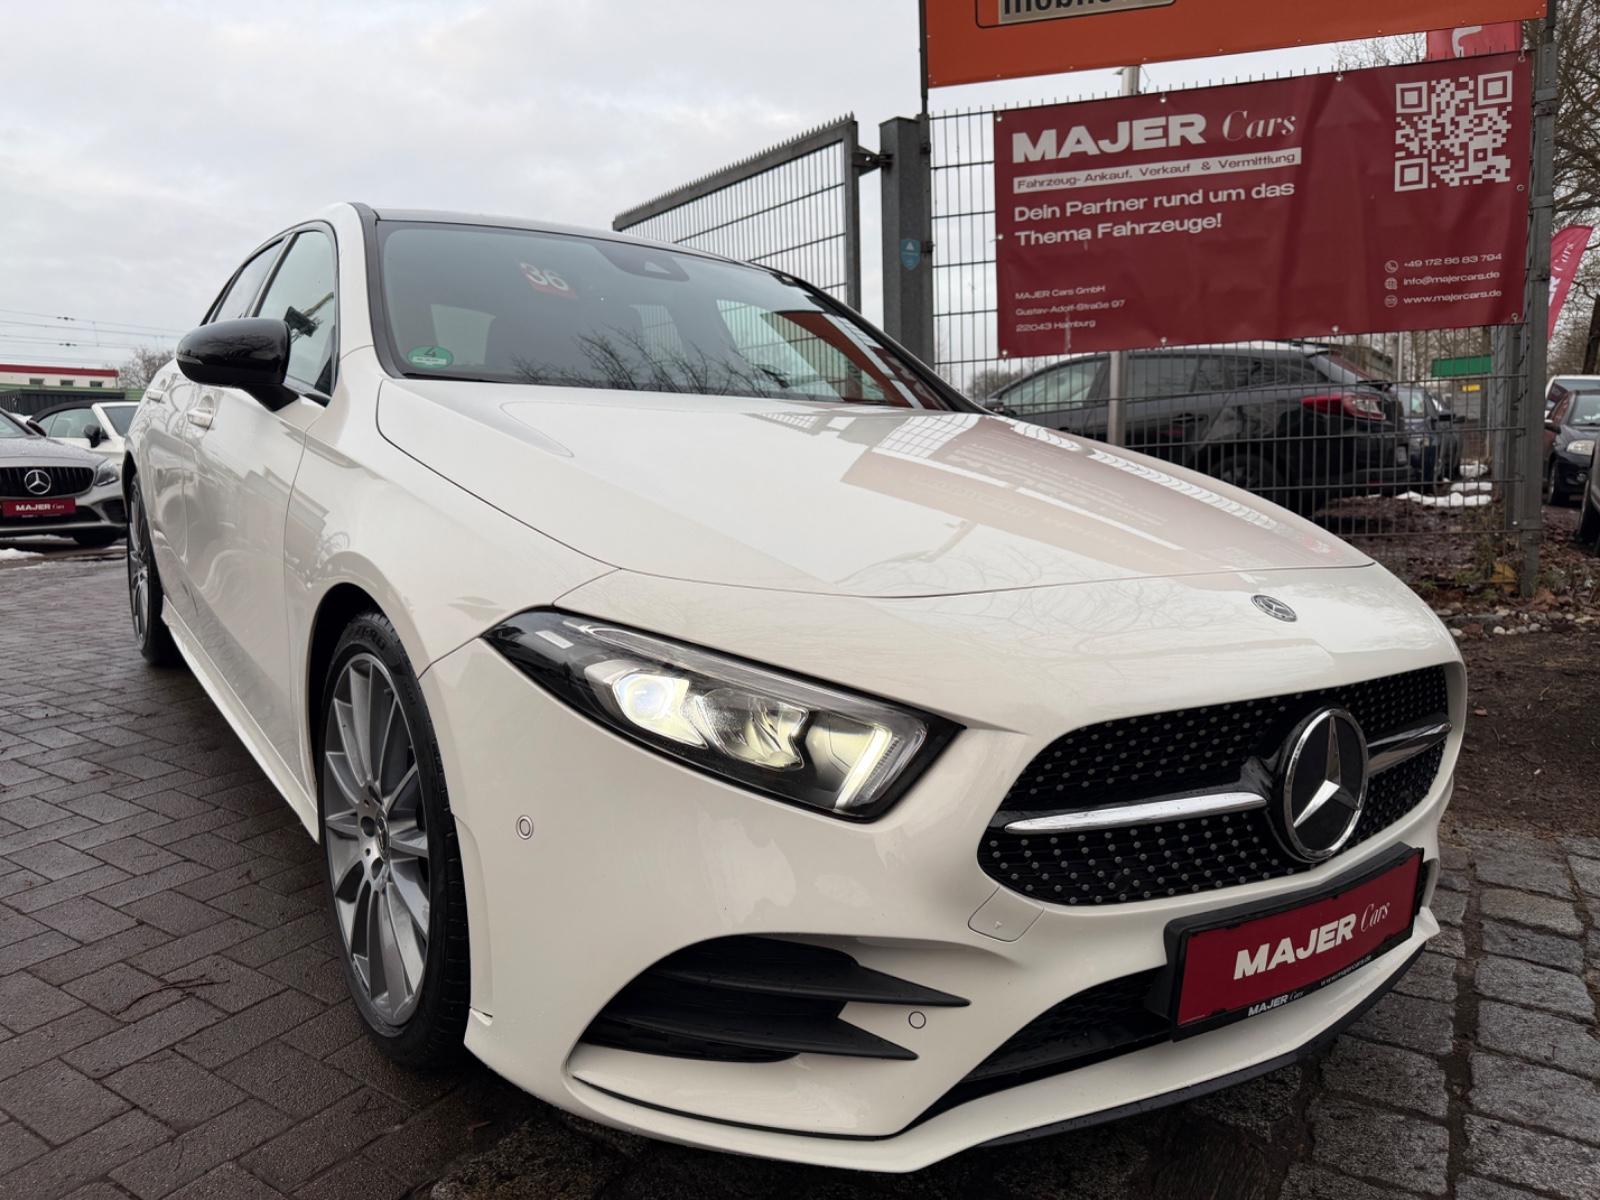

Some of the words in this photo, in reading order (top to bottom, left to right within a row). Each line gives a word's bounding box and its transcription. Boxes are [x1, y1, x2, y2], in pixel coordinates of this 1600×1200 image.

[1012, 113, 1206, 163] MAJER
[1222, 110, 1297, 141] Cars
[1017, 176, 1081, 190] Fahrzeug-
[1140, 163, 1191, 177] Verkauf
[1201, 161, 1211, 171] &
[1218, 152, 1296, 169] Vermittlung
[1014, 203, 1060, 222] Dein
[1066, 196, 1148, 217] Partner
[1153, 189, 1203, 209] rund
[1209, 186, 1245, 203] um
[1251, 182, 1295, 199] das
[1014, 228, 1092, 246] Thema
[1097, 213, 1222, 239] Fahrzeuge!
[1425, 258, 1442, 267] 172
[1403, 271, 1500, 286] info@majercars.de
[1015, 289, 1050, 300] MAJER
[1051, 288, 1074, 297] Cars
[1075, 284, 1106, 295] GmbH
[1403, 289, 1502, 304] www.majercars.de
[1053, 320, 1096, 330] Hamburg
[15, 503, 51, 511] MAJER
[1234, 913, 1356, 980] MAJER
[1361, 902, 1390, 932] Cars
[1248, 994, 1288, 1017] MAJER
